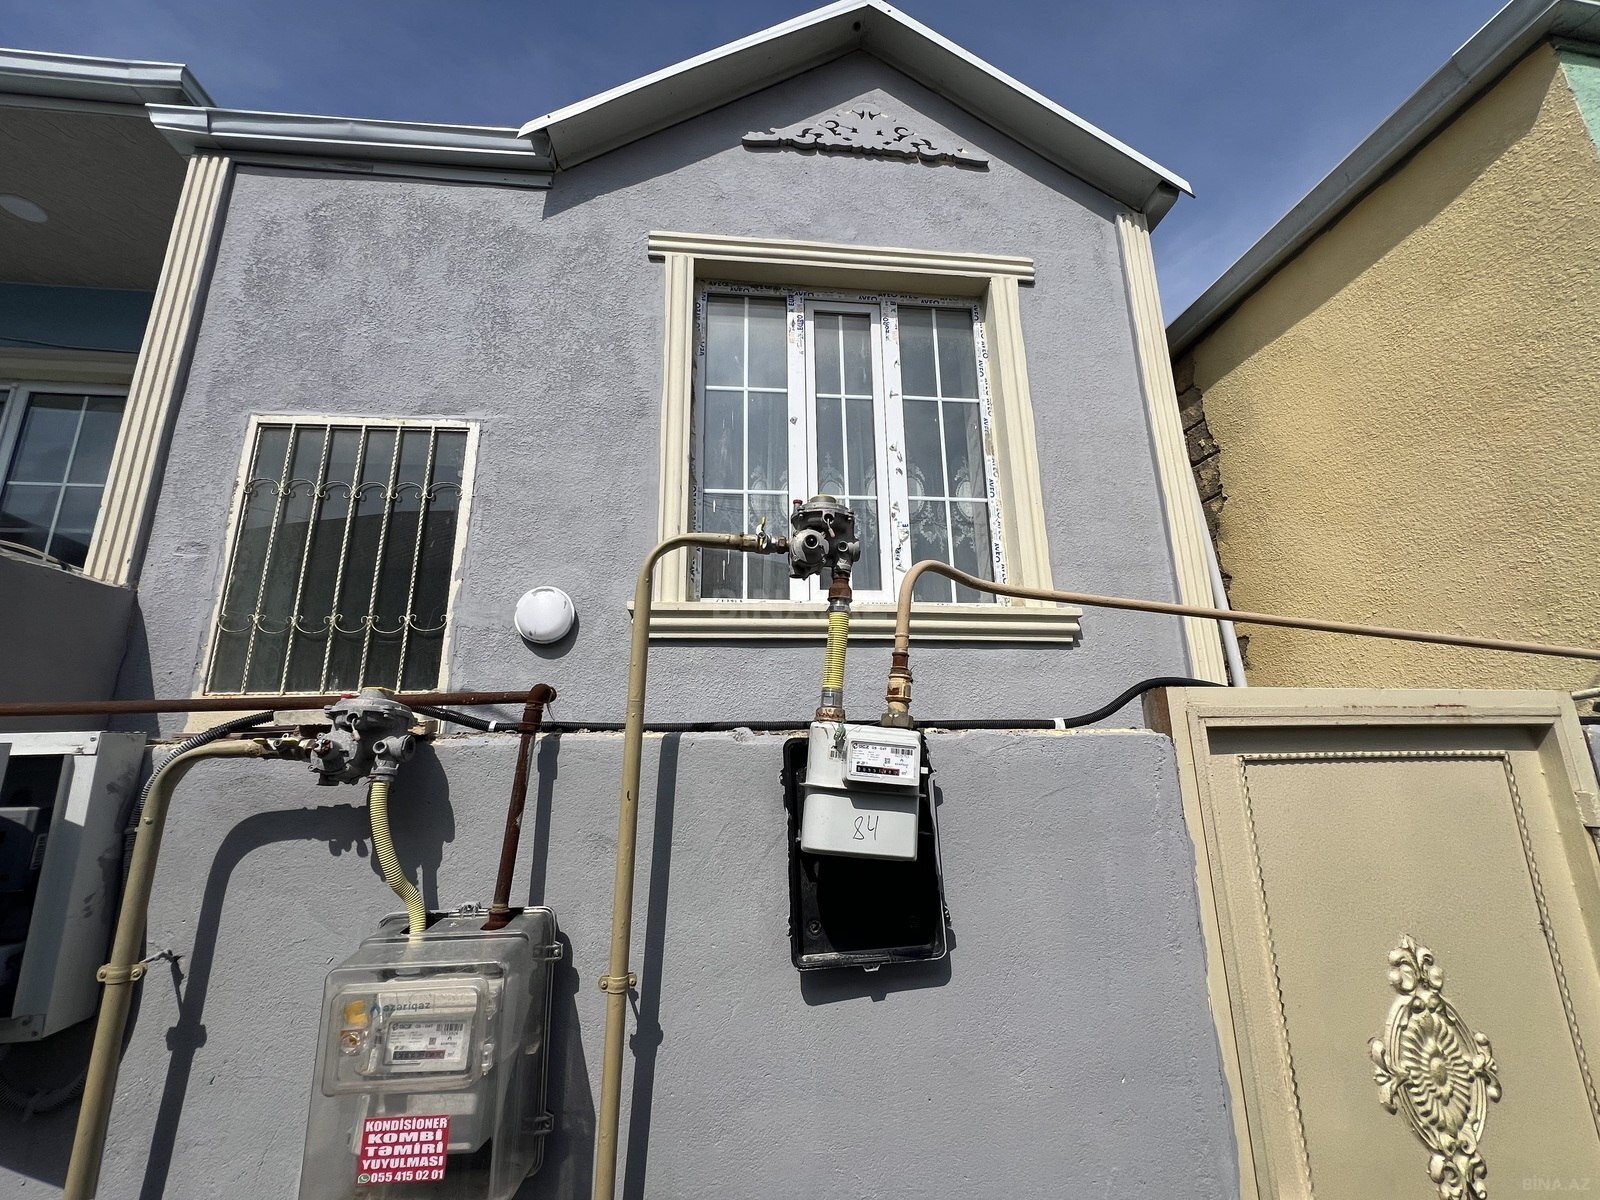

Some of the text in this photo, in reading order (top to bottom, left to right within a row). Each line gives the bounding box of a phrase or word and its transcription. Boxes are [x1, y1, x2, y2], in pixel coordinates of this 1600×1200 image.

[853, 815, 879, 840] 84
[365, 1117, 448, 1132] KONDİSİONER
[367, 1129, 443, 1144] KOMBİ
[362, 1156, 444, 1170] YUYULMASI
[370, 1169, 444, 1183] 055 415 02 01
